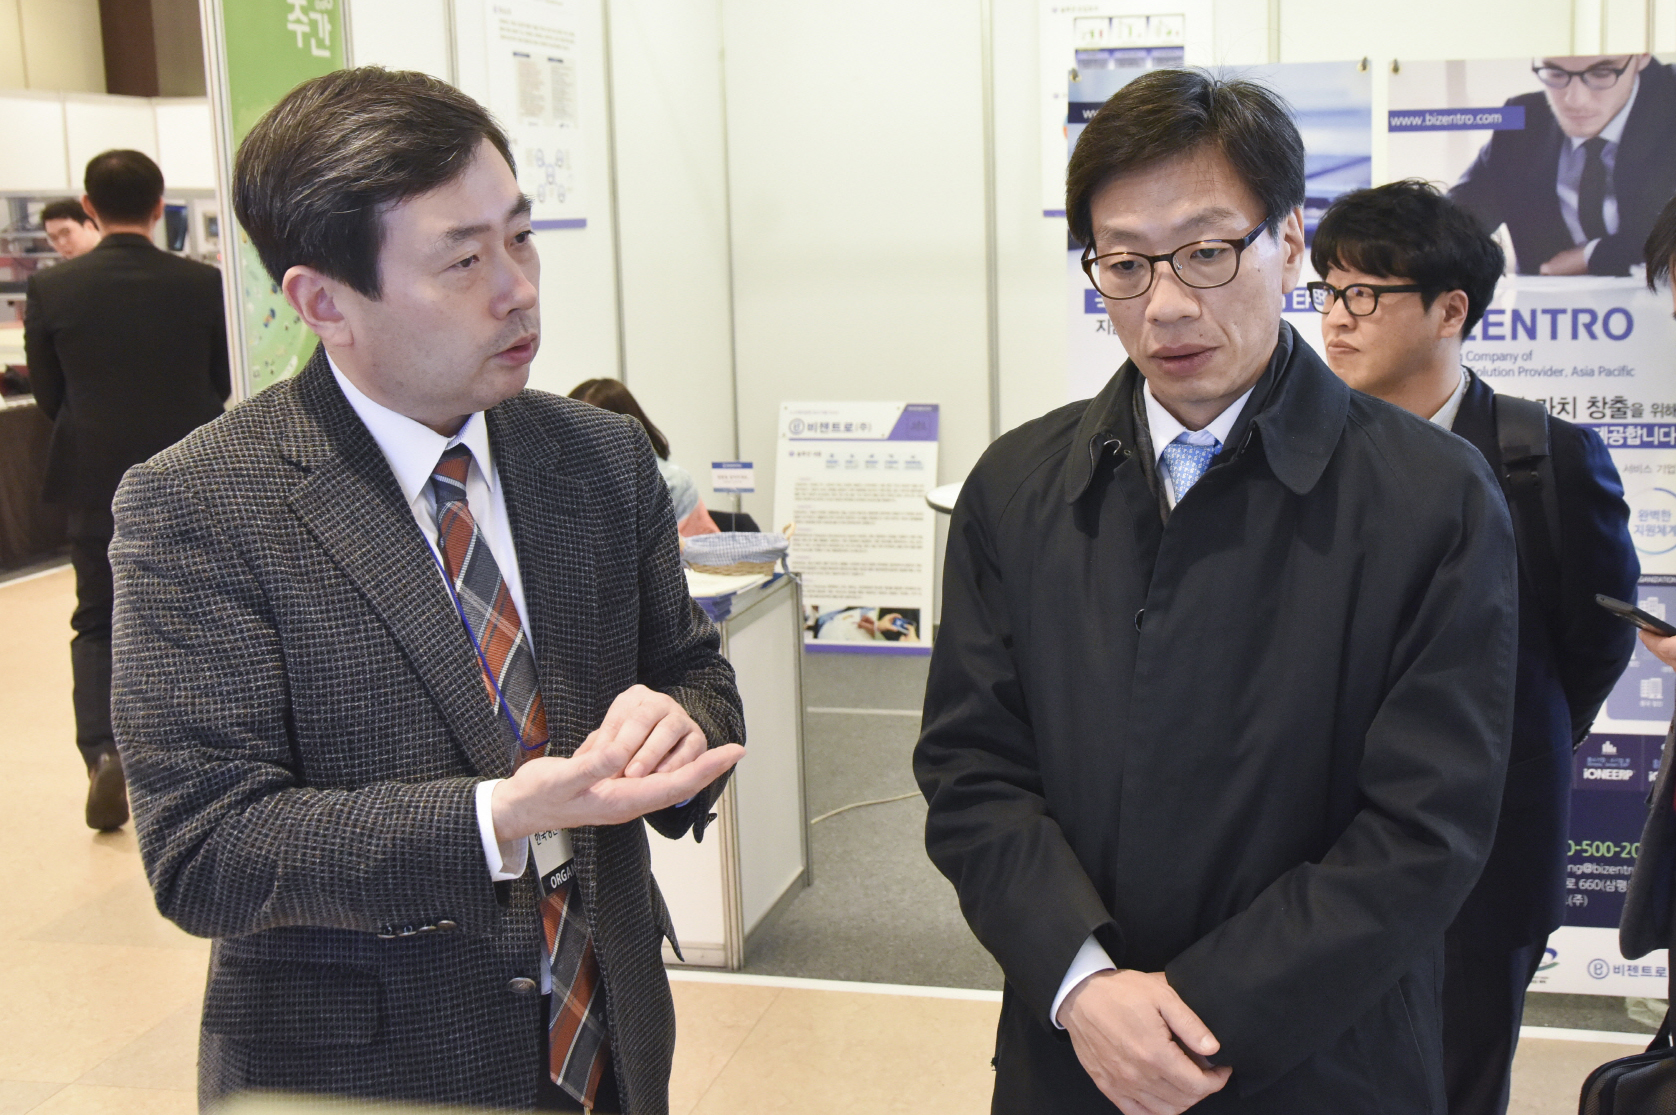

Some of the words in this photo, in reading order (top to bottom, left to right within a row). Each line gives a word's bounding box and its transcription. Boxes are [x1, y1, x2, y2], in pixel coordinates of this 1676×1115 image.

[286, 0, 332, 58] 주간
[1390, 112, 1503, 127] www.bizentro.com
[1465, 307, 1635, 341] ENTRO
[1466, 350, 1518, 364] Company
[1521, 350, 1533, 362] of
[1571, 365, 1596, 377] Asia
[1598, 365, 1636, 378] Pacific
[1587, 396, 1645, 420] 창출을
[1578, 878, 1631, 893] 660(삼평
[1566, 893, 1589, 907] (주)
[1613, 964, 1668, 978] 비젠트로
